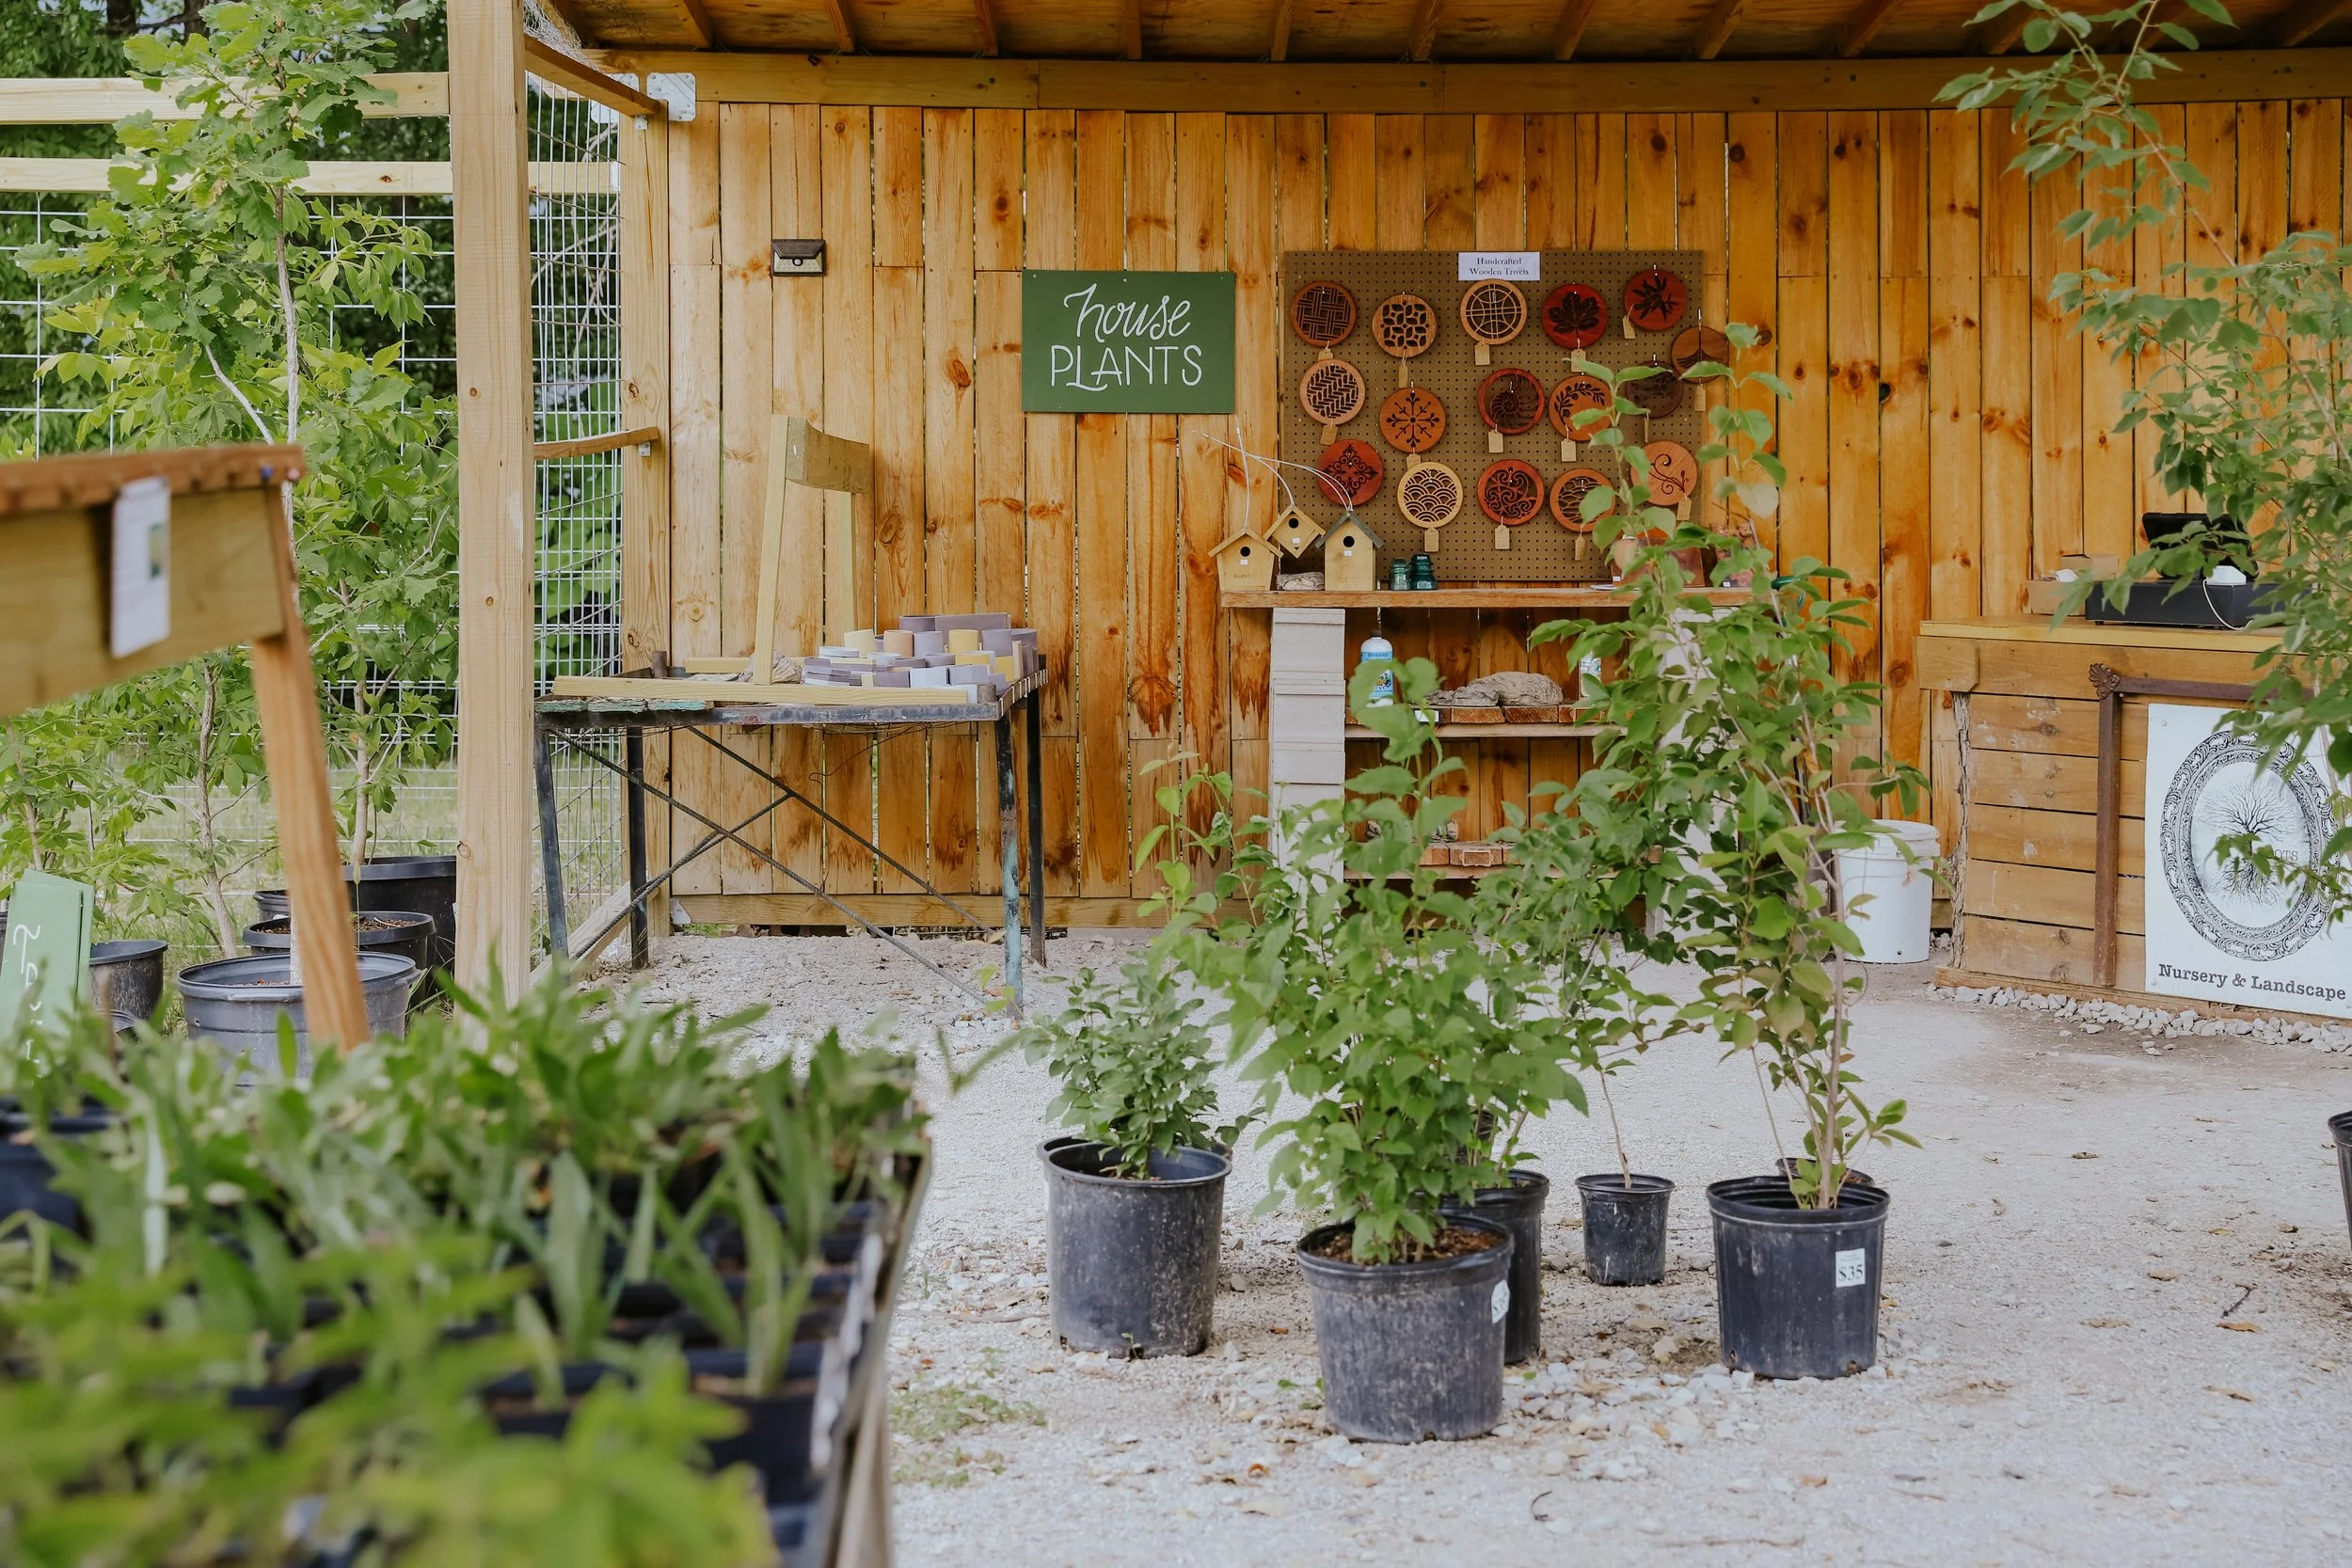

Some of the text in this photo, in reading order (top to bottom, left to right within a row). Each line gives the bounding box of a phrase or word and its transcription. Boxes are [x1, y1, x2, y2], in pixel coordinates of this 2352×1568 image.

[1469, 267, 1530, 276] Wooden Trivets
[1476, 257, 1522, 265] Handcrafted
[1051, 344, 1202, 391] PLANTS
[2157, 963, 2346, 1002] Nursery & Landscape
